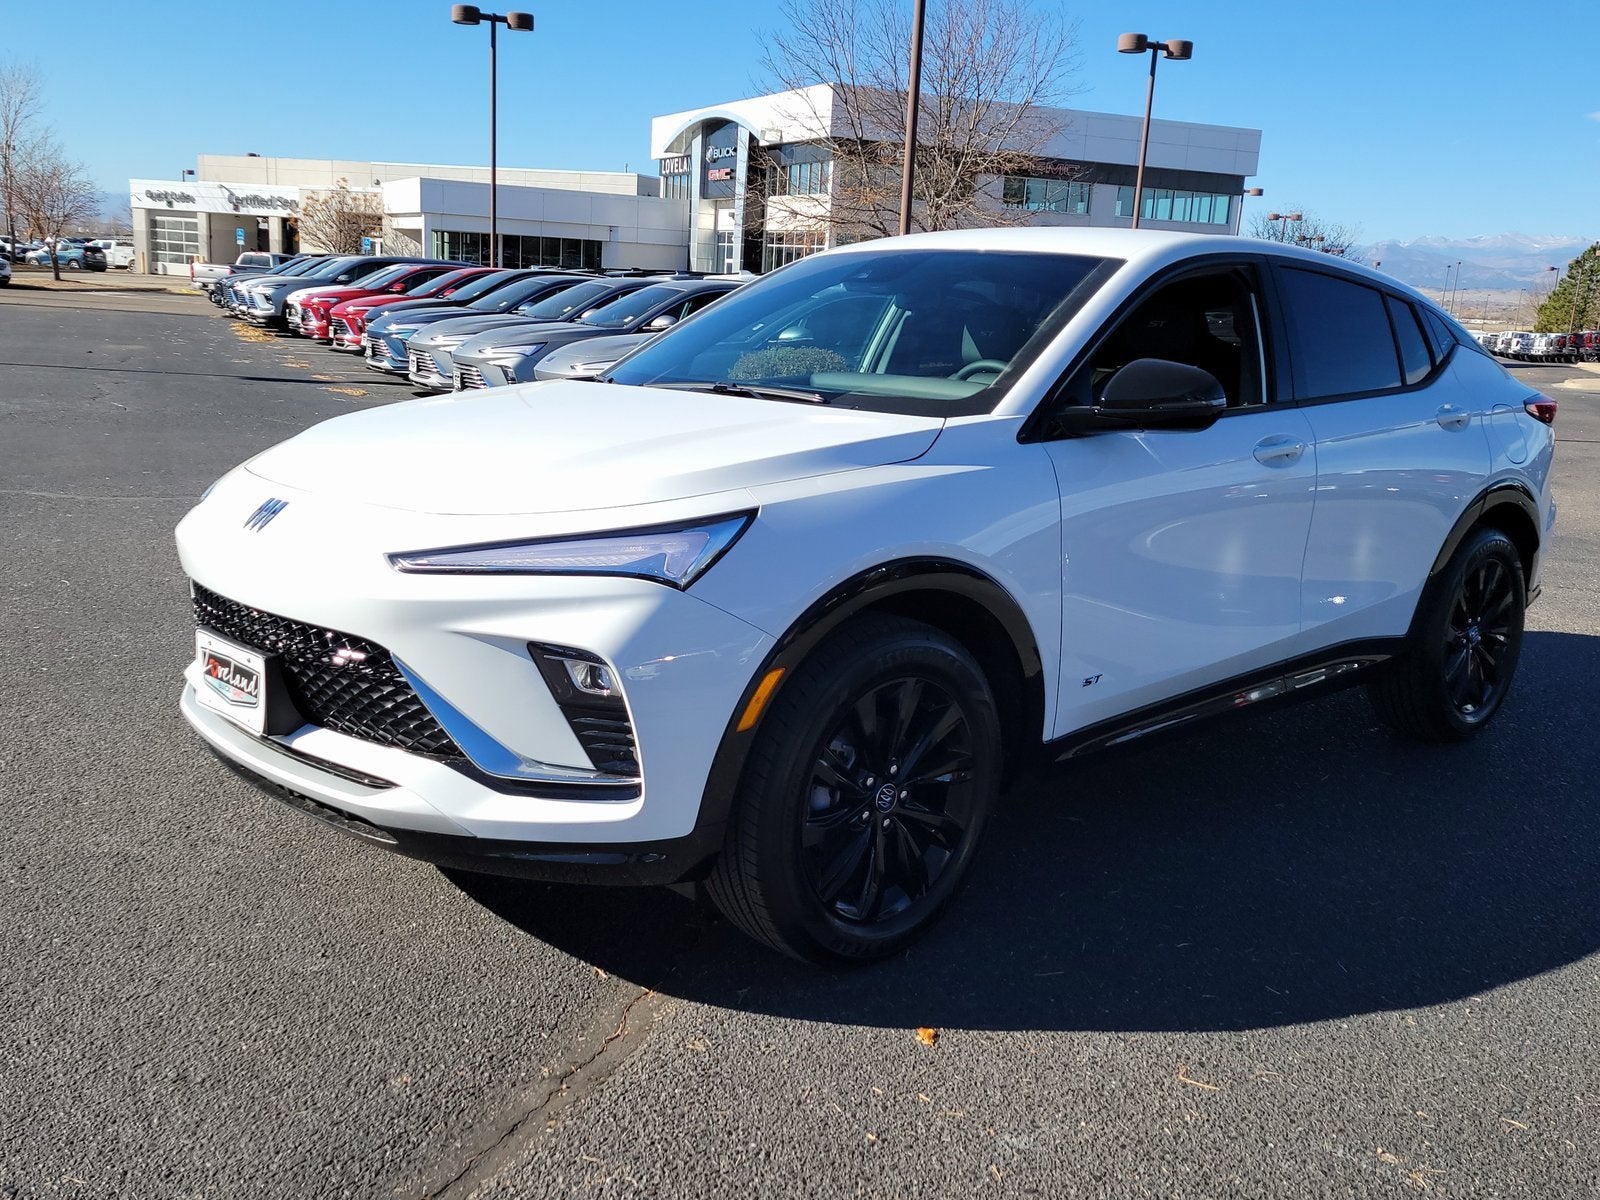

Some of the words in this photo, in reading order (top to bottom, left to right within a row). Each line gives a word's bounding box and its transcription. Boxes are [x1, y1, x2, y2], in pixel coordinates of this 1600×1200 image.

[713, 147, 735, 158] BUICK
[708, 168, 731, 181] GMC
[1082, 673, 1103, 687] ST
